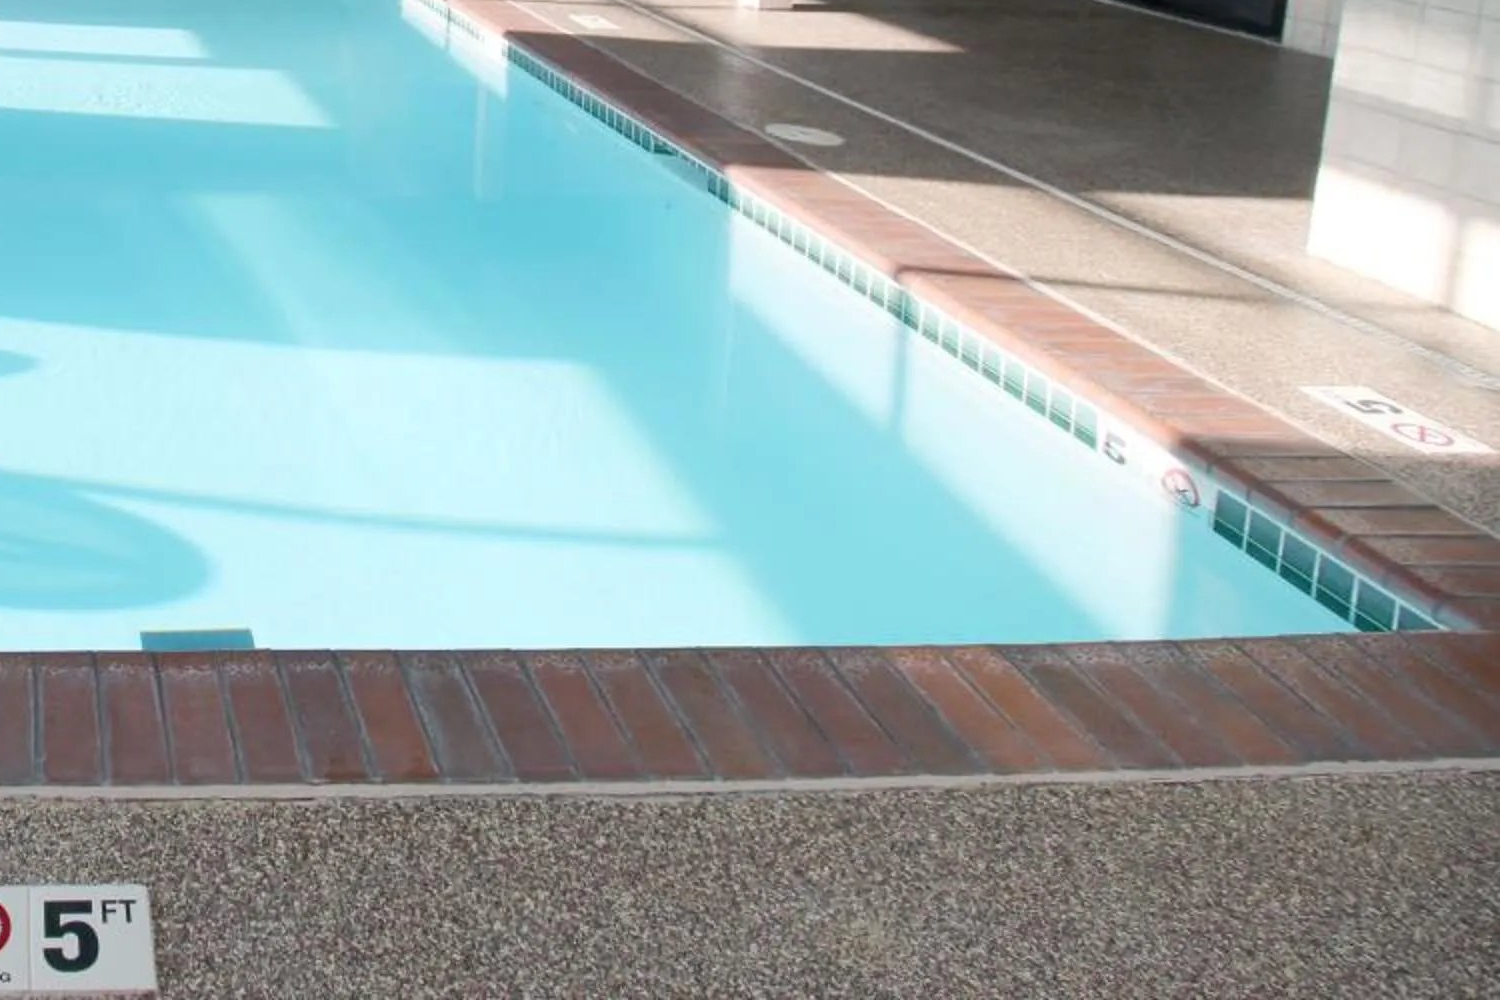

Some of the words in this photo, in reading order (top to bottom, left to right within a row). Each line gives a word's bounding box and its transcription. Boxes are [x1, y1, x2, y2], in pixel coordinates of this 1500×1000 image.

[1102, 431, 1126, 466] 5
[43, 899, 100, 973] 5
[101, 899, 137, 924] FT
